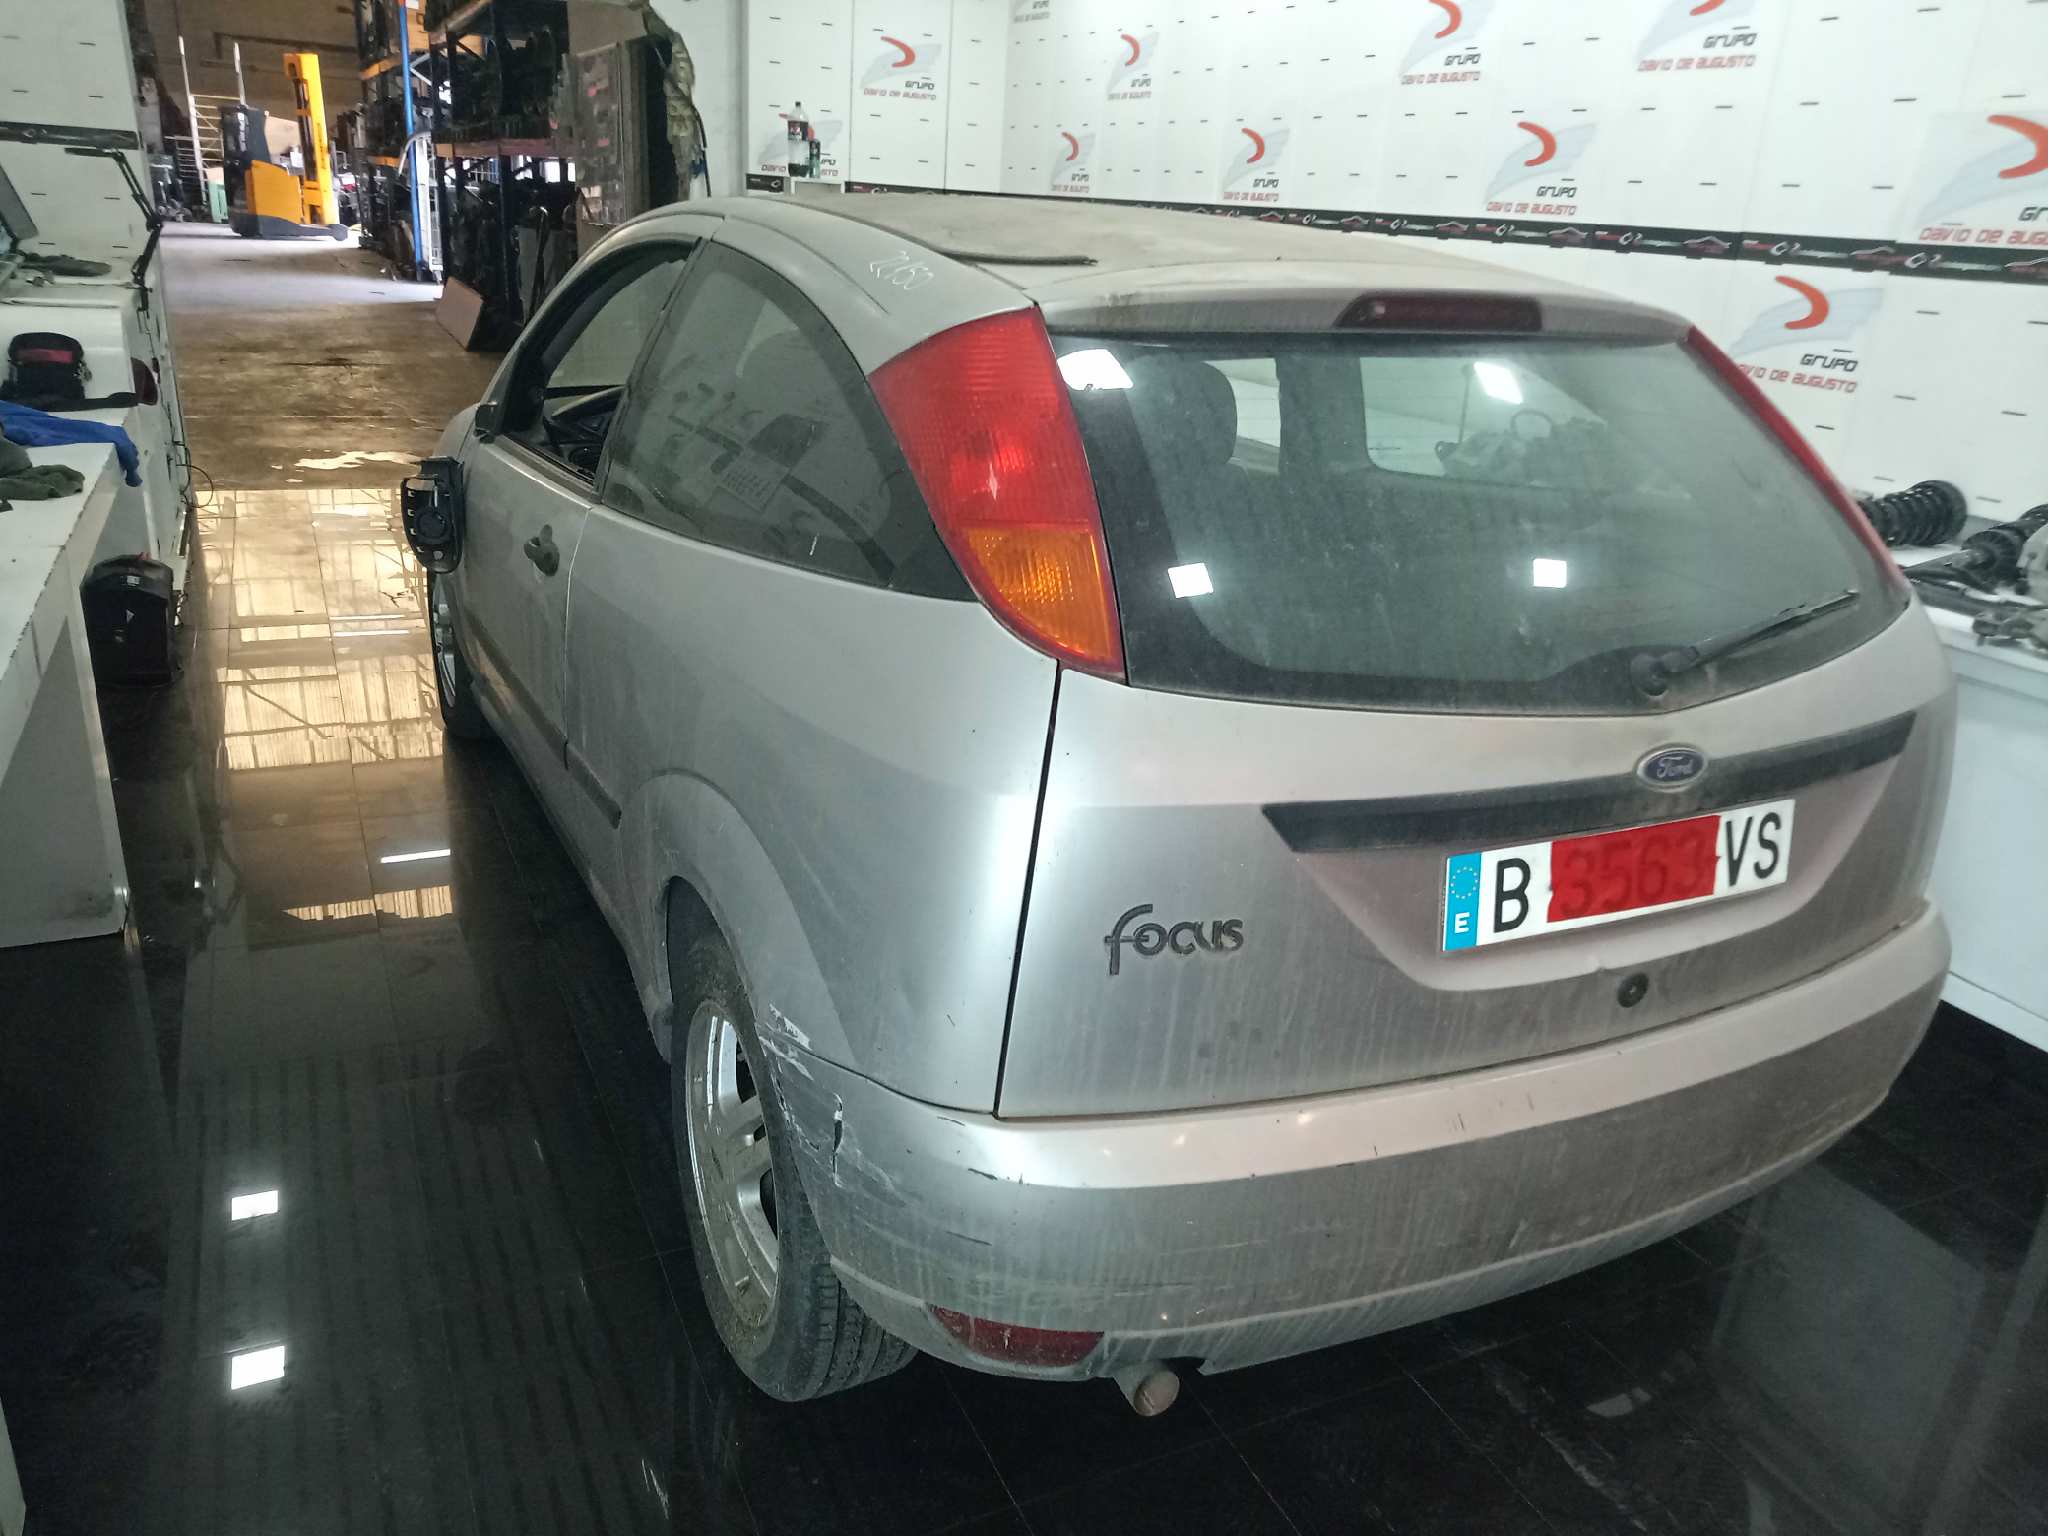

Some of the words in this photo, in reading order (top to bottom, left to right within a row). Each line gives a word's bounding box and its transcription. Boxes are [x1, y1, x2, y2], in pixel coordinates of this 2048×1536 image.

[1536, 186, 1578, 198] GRUPO
[1800, 353, 1858, 373] GRUPO
[1656, 755, 1694, 778] Ford
[1493, 857, 1532, 933] B
[1725, 811, 1782, 887] VS
[1454, 911, 1471, 934] E
